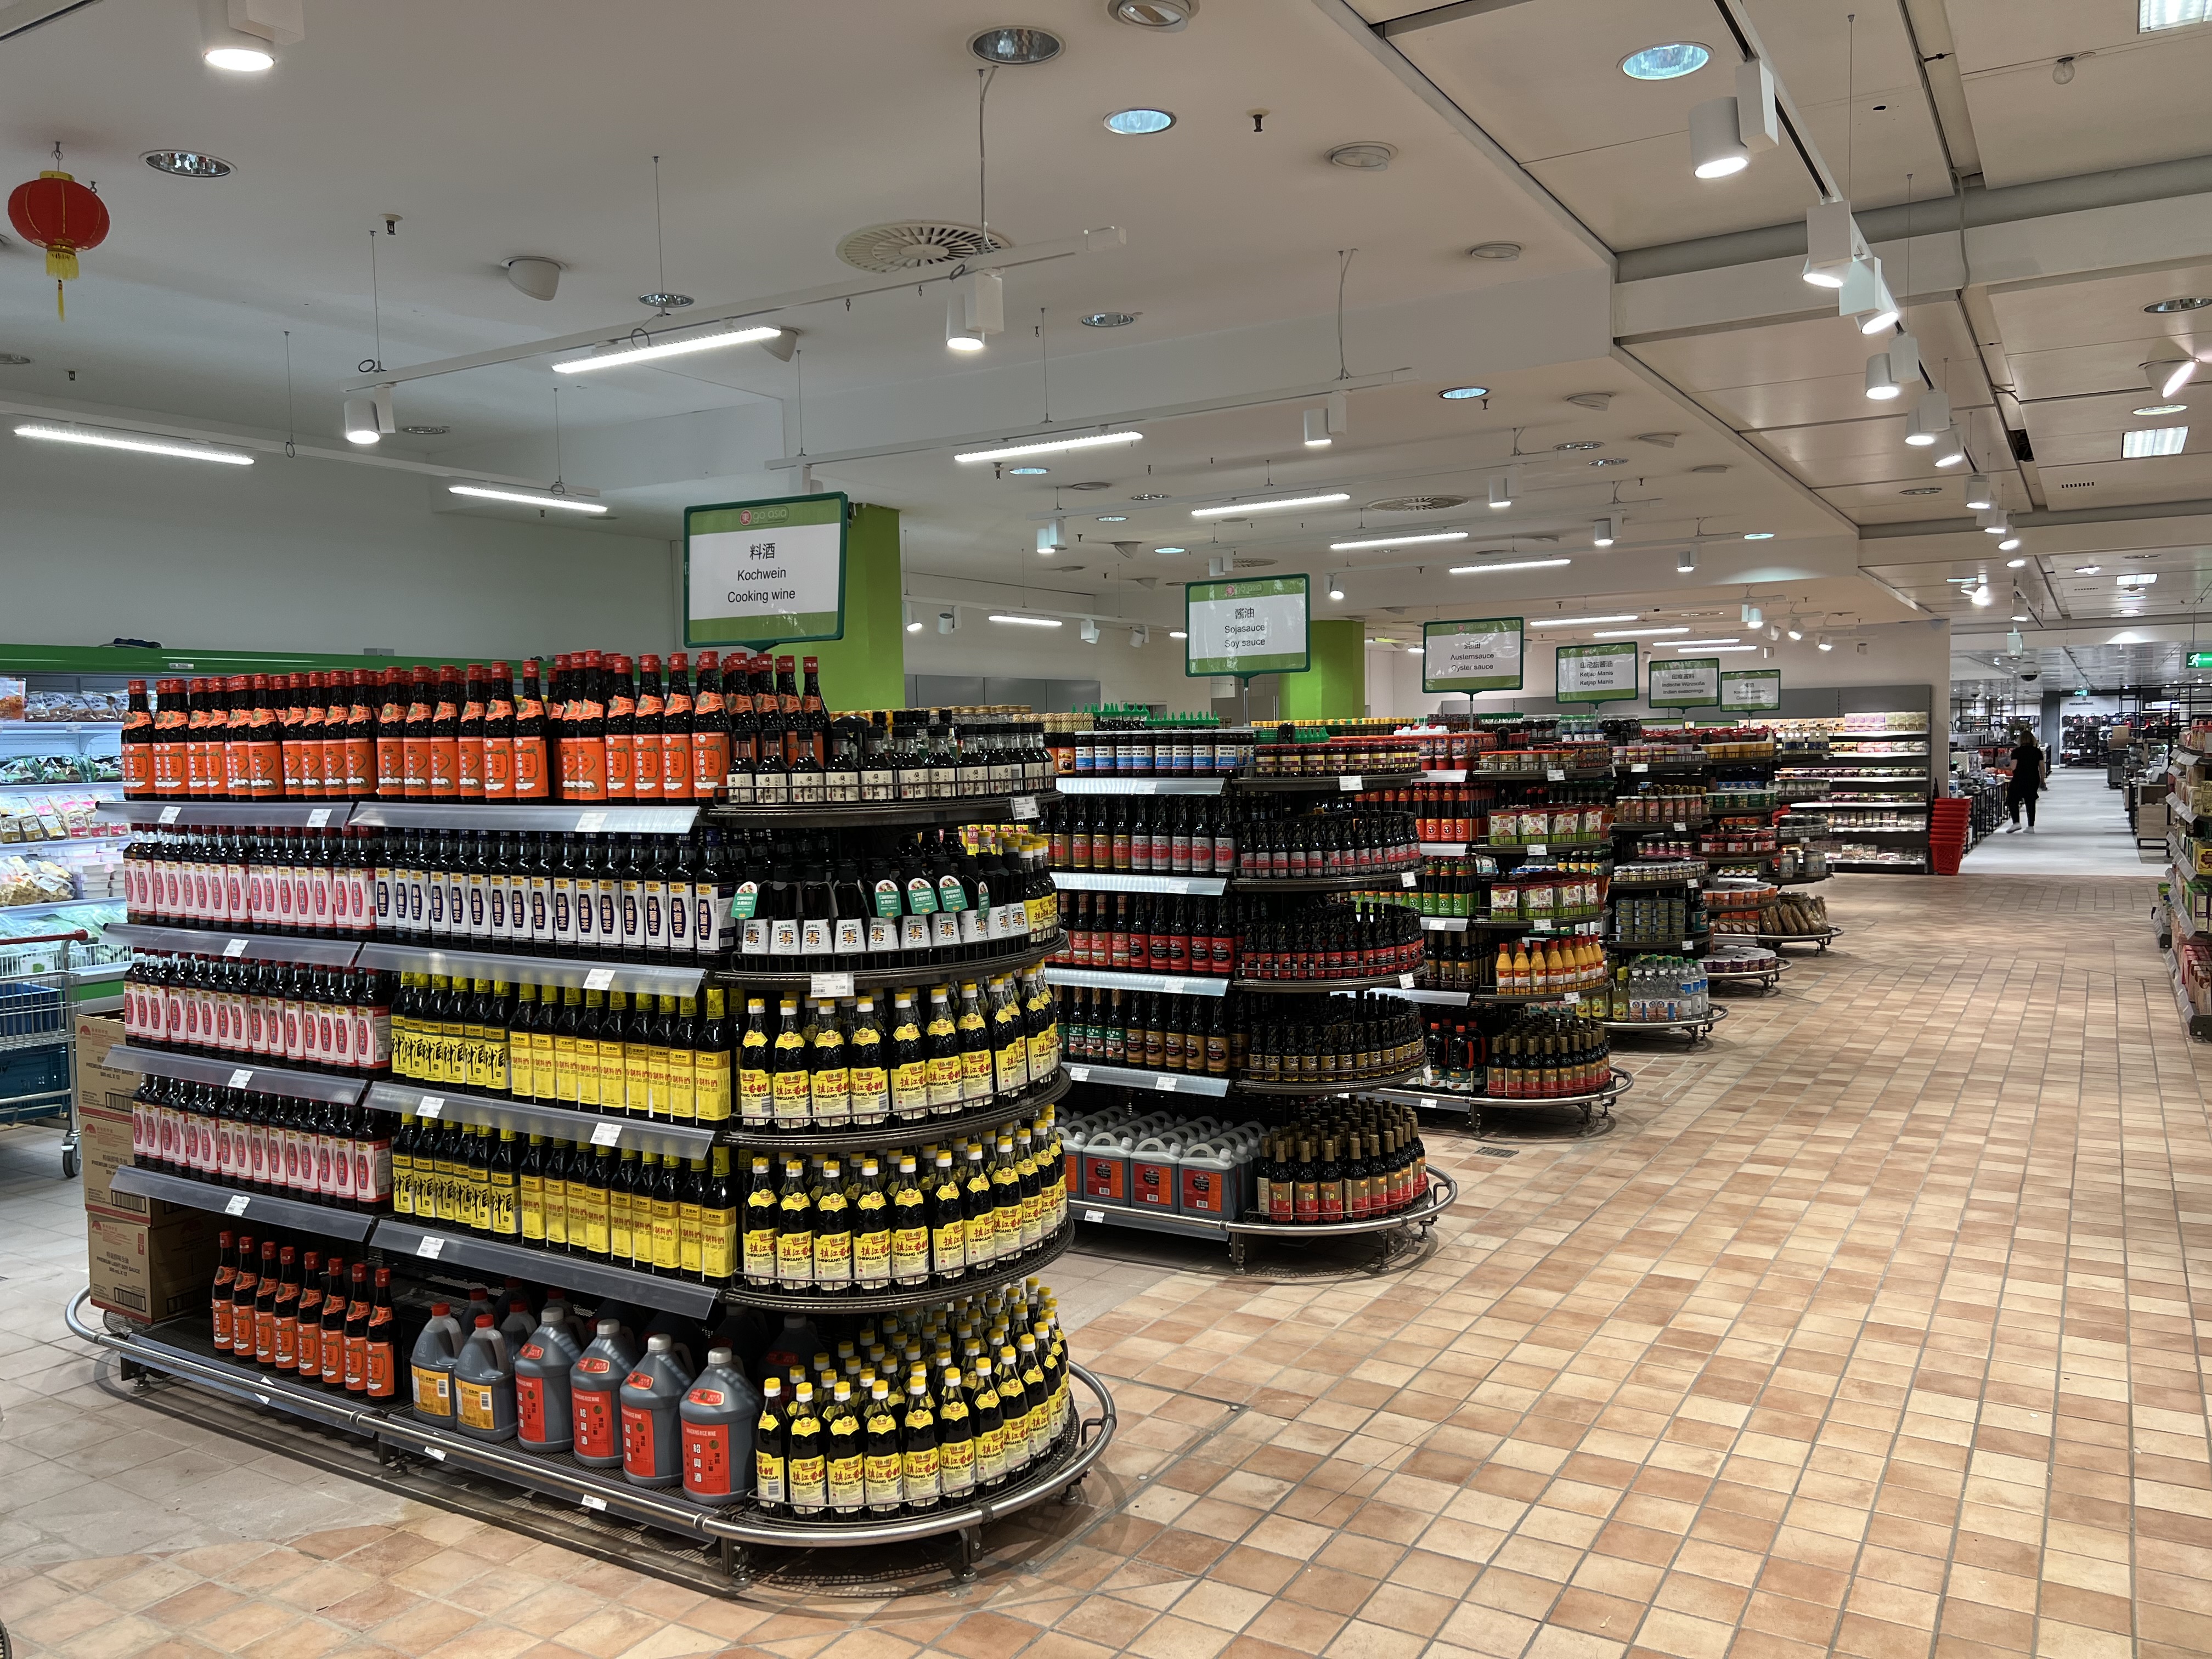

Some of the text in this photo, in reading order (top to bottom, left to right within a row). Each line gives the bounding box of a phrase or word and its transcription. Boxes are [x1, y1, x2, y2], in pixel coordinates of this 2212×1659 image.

[753, 509, 787, 522] go asia
[749, 543, 776, 561] 料酒
[737, 567, 786, 581] Kochwein
[727, 588, 795, 603] Cooking wine
[1224, 624, 1265, 634] Sojasauce
[1224, 638, 1266, 649] Soy sauce
[900, 1075, 927, 1086] 镇江香
[742, 1082, 767, 1092] 江香醋
[749, 1241, 776, 1253] 镇江香
